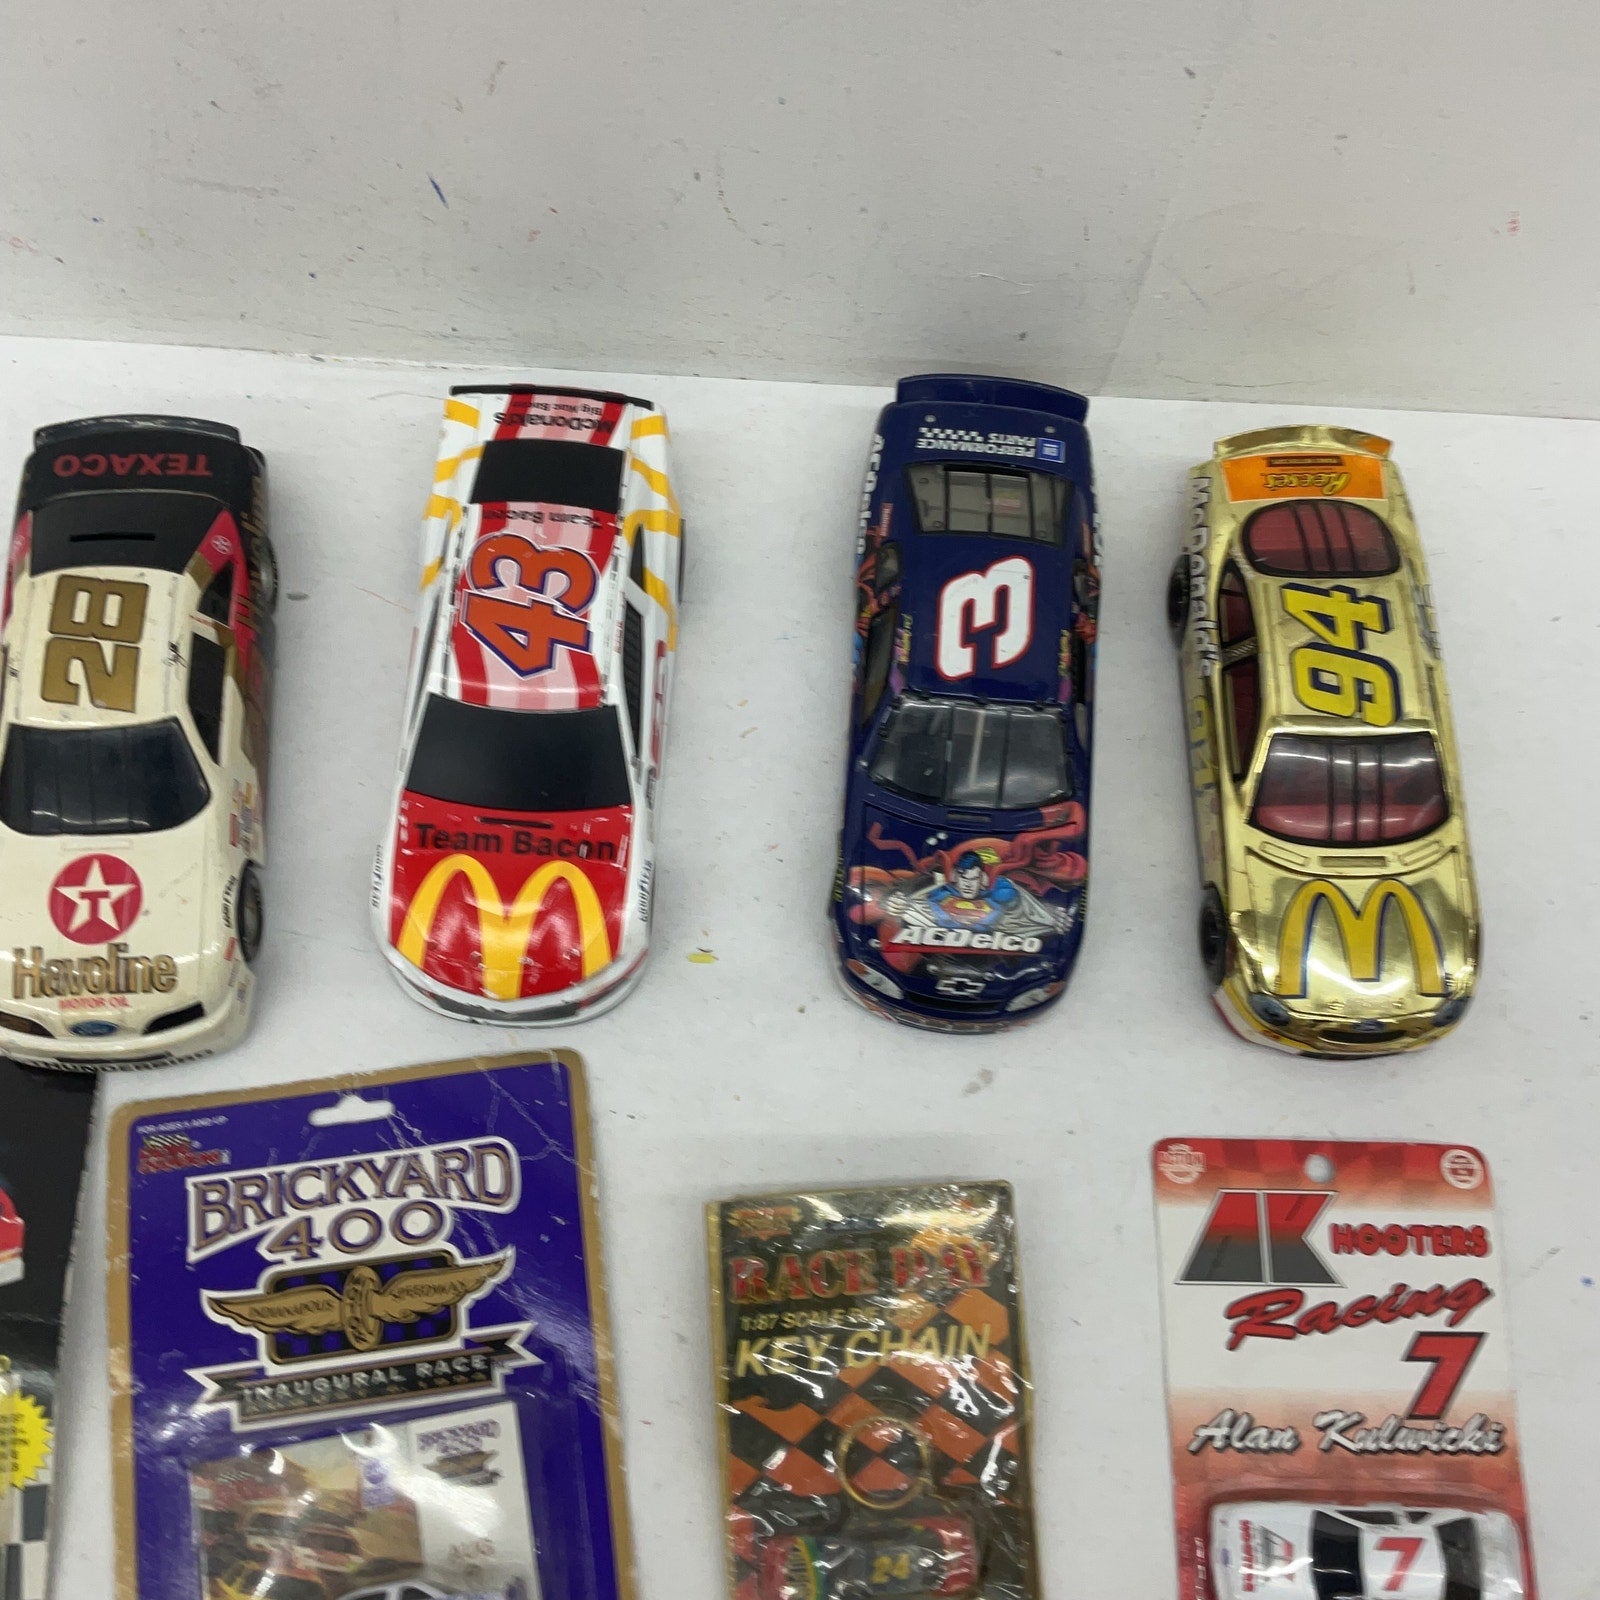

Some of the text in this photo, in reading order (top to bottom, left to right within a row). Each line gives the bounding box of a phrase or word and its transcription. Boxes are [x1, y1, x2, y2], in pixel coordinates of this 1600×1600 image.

[53, 453, 213, 477] TEXACO
[915, 438, 1036, 458] PERFORMANCE
[987, 433, 1036, 447] PARTS
[460, 533, 601, 681] 43
[935, 556, 1035, 681] 3
[40, 573, 149, 713] 28
[1280, 582, 1402, 727] 94
[415, 823, 616, 861] Team Bacon
[892, 926, 1043, 953] ACDelco
[12, 943, 178, 999] Havoline
[59, 996, 130, 1010] MOTOR OIL
[196, 1143, 513, 1250] BRICKYARD
[264, 1200, 446, 1261] 400
[1329, 1223, 1491, 1257] HOOTERS
[730, 1248, 879, 1305] RACE
[1223, 1278, 1494, 1351] Racing
[242, 1354, 488, 1401] INAUGURAL RACE
[732, 1323, 992, 1378] KEY CHAIN
[1401, 1331, 1489, 1421] 7
[1188, 1408, 1506, 1456] Alan Kulwicki
[868, 1554, 912, 1585] 24
[1372, 1536, 1426, 1591] 7
